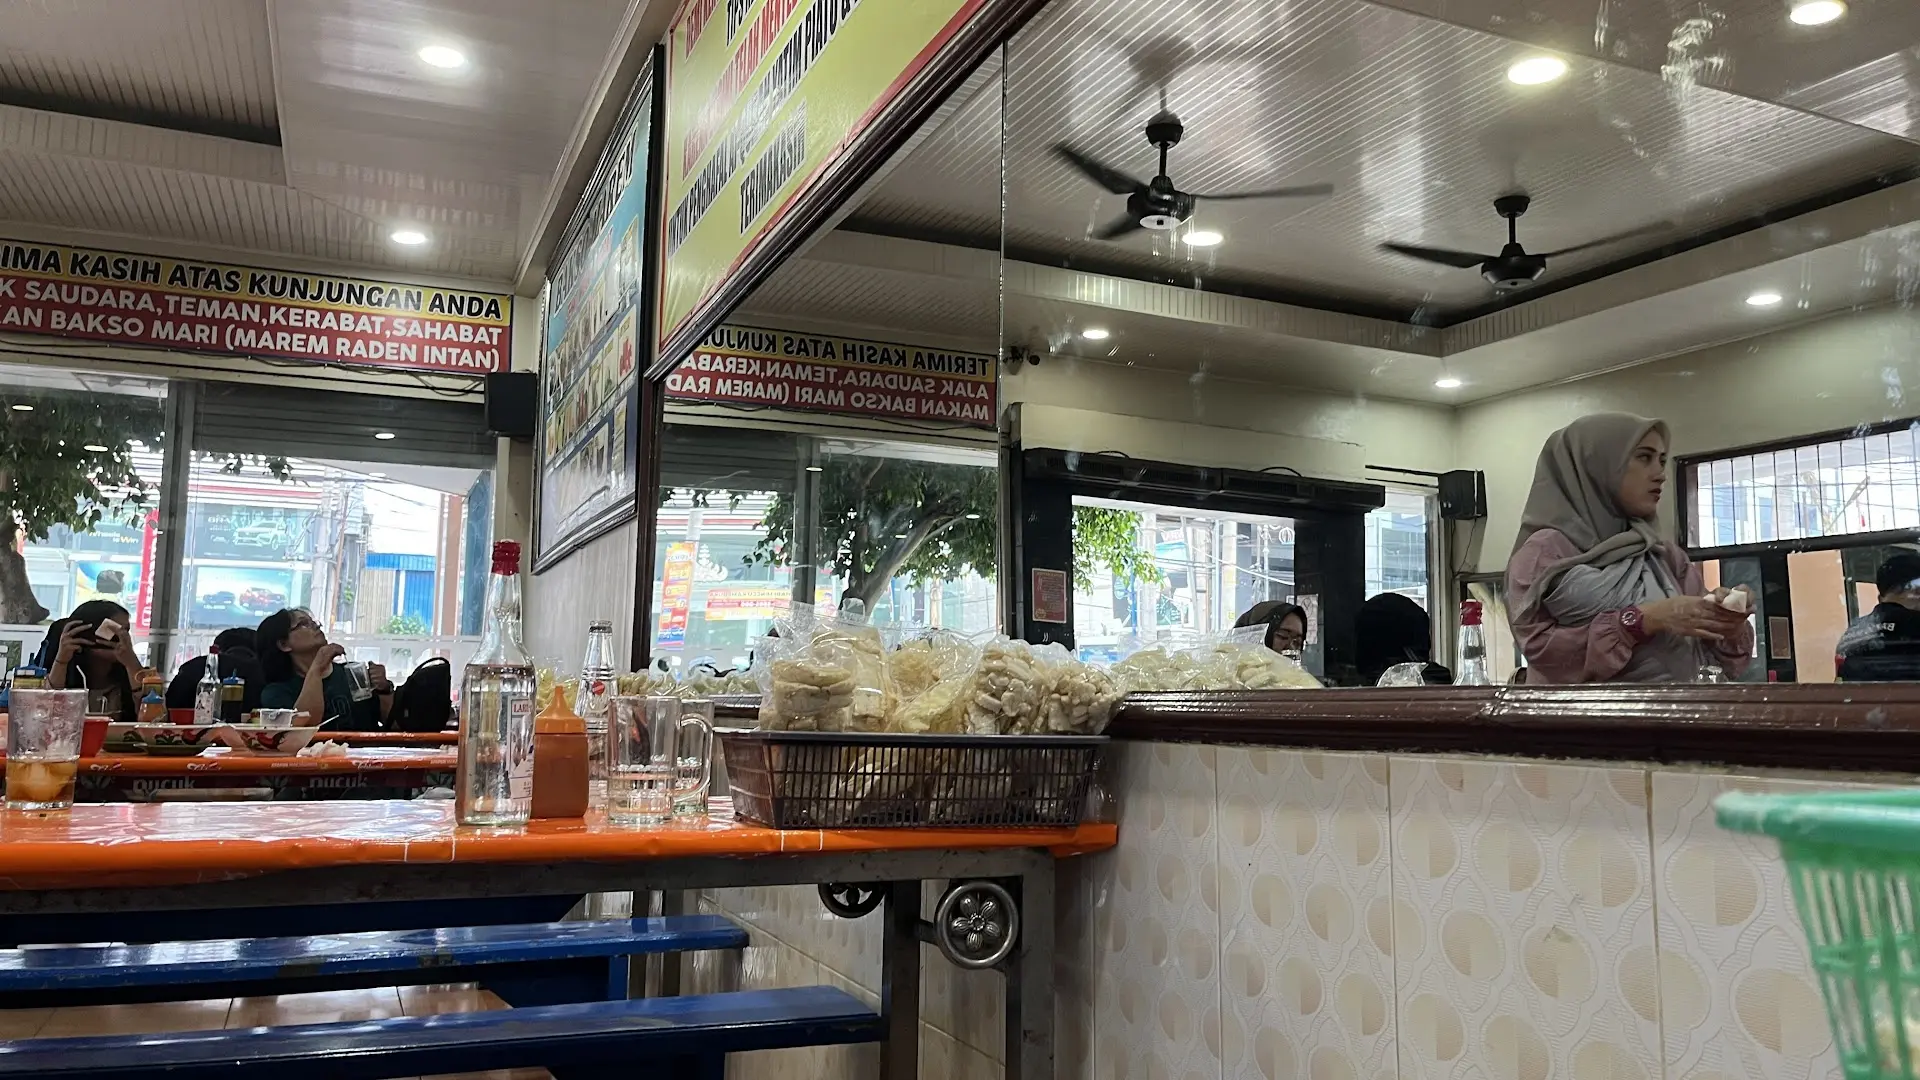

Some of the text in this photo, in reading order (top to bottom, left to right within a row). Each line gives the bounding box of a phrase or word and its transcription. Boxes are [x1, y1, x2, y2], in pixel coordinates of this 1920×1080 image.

[70, 252, 162, 284] KASIH
[168, 264, 241, 293] ATAS
[249, 272, 422, 312] KUNJUNGAN
[428, 293, 502, 319] ANDA
[0, 304, 500, 373] AN BAKSO MARI (MAREM RADEN INTAN)
